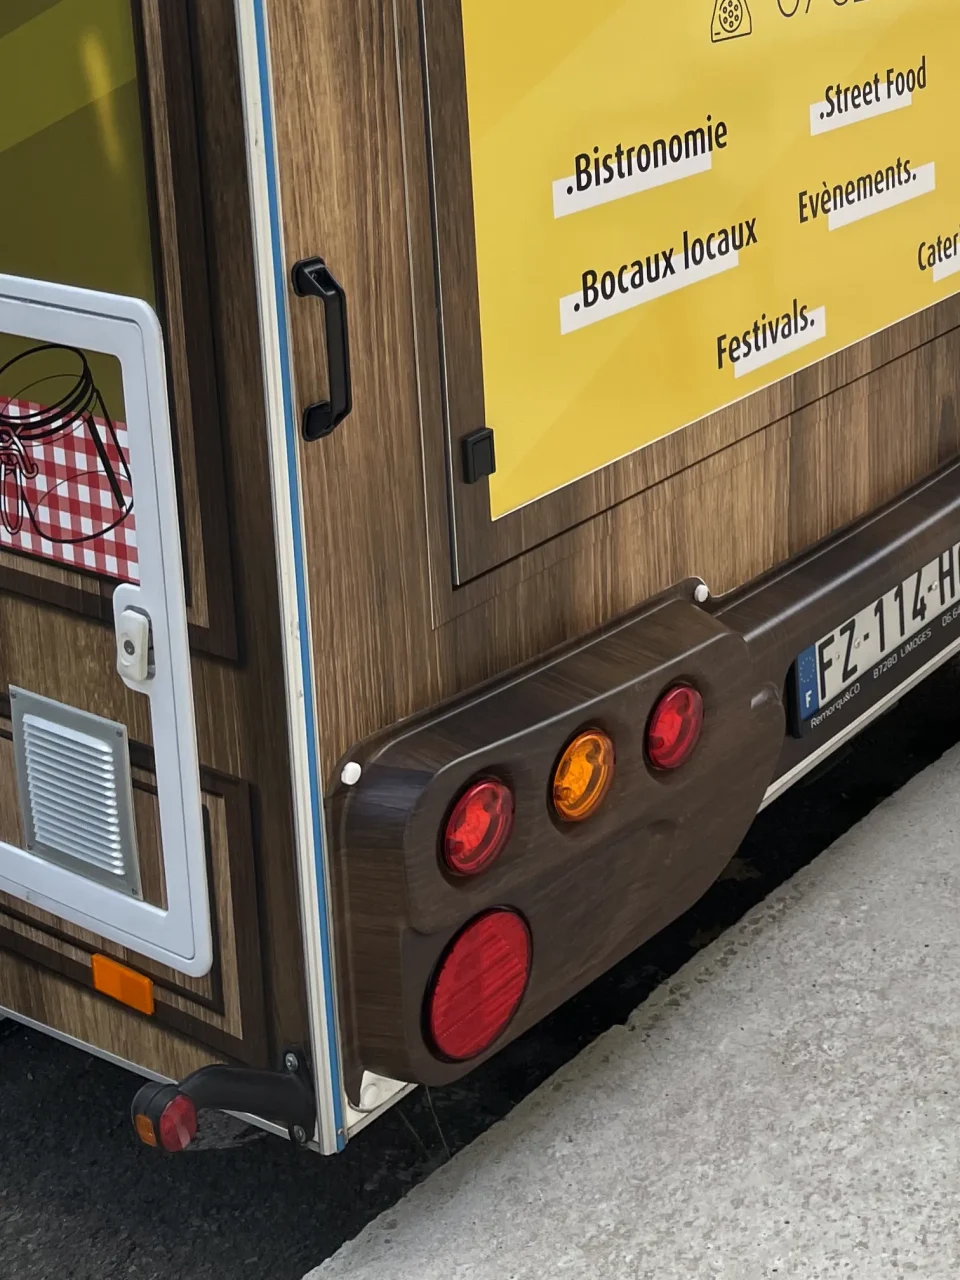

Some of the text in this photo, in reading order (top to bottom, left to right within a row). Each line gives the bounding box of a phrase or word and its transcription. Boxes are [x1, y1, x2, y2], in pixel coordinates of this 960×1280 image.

[886, 55, 927, 100] Food
[798, 157, 917, 224] Evènements.
[682, 217, 758, 270] locaux
[716, 298, 815, 370] Festivals.
[873, 654, 899, 679] 87280
[900, 629, 932, 658] LIMOGES
[805, 690, 813, 708] F
